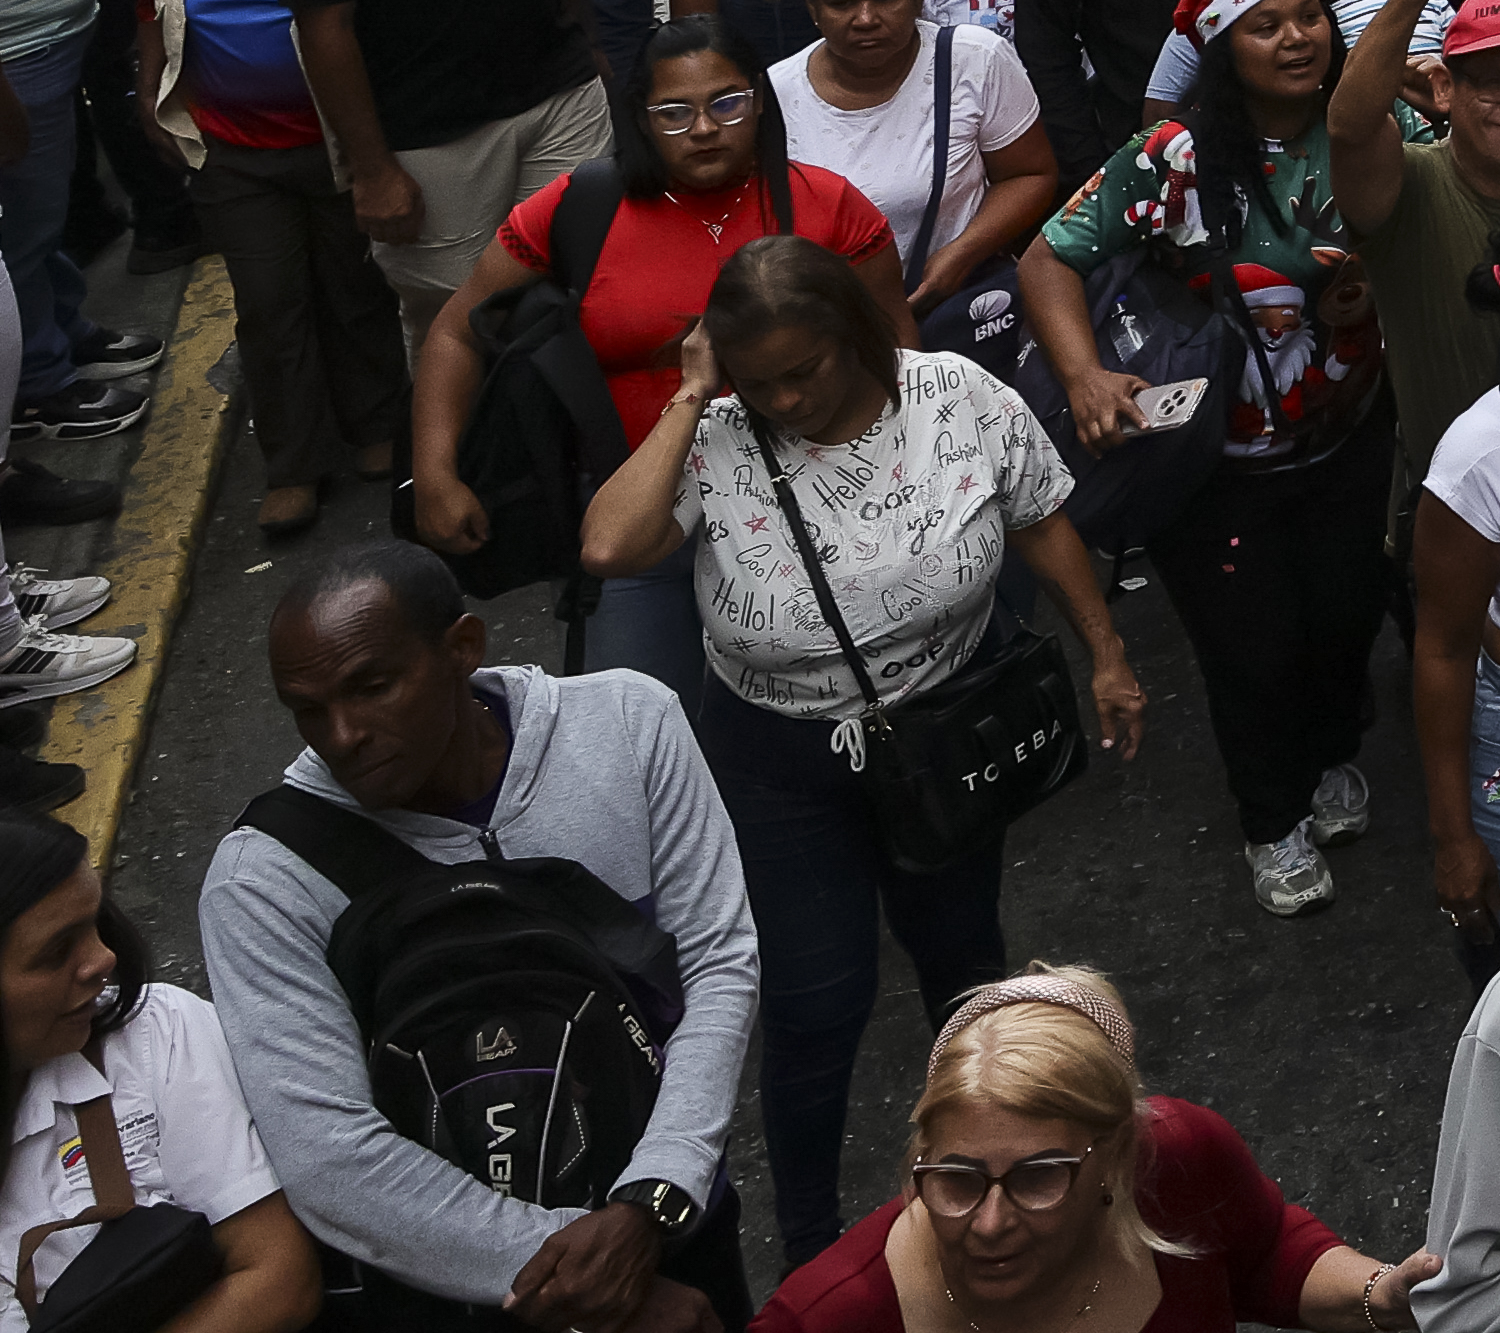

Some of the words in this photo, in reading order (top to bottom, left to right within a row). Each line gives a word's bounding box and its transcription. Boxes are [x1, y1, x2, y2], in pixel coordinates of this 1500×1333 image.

[975, 313, 1016, 342] BNC
[903, 363, 967, 406] Hello!
[821, 452, 882, 511] Hello!
[711, 577, 776, 633] Hello!
[623, 1014, 661, 1076] GEAR
